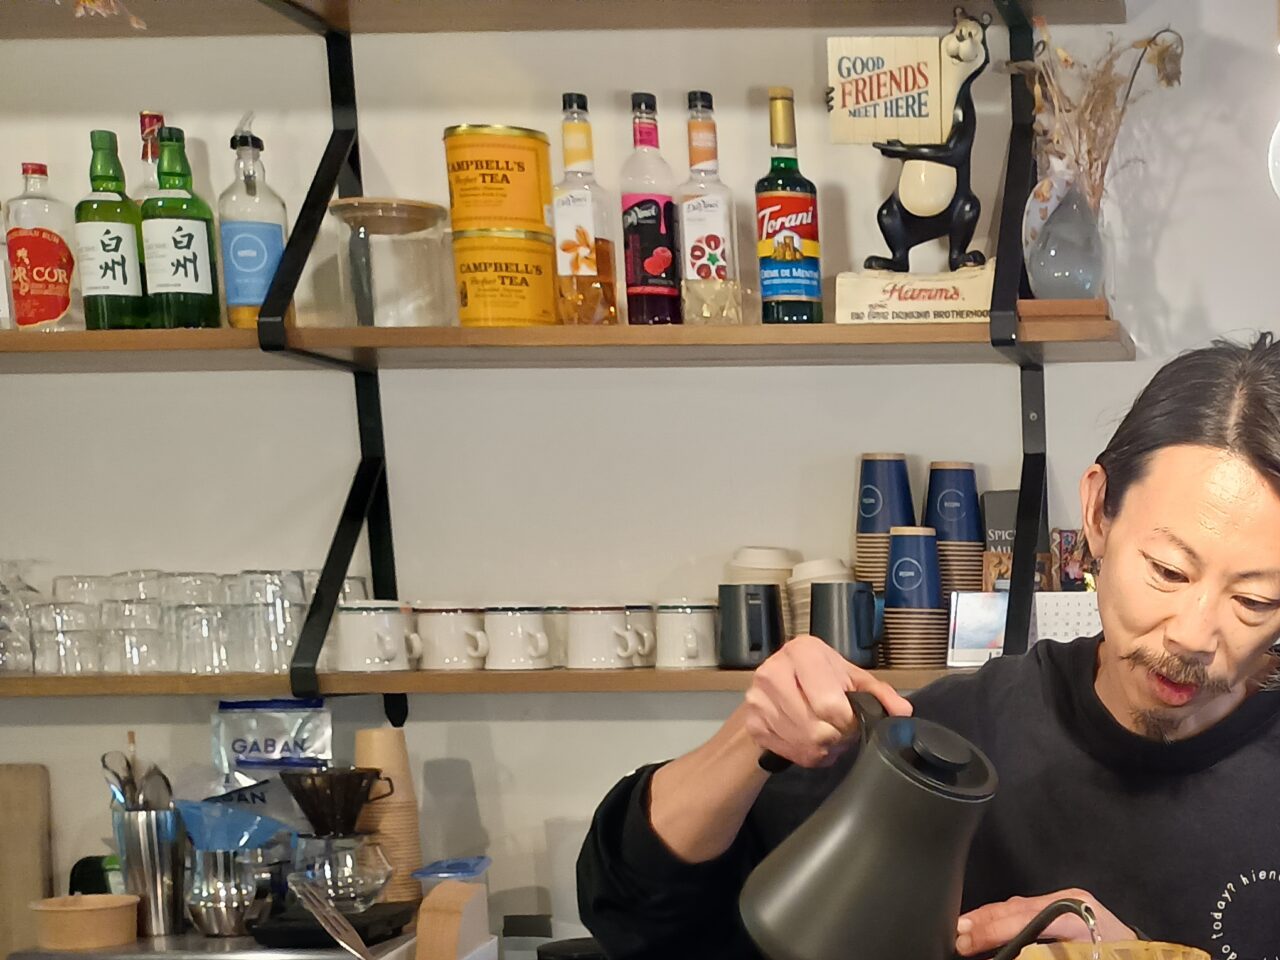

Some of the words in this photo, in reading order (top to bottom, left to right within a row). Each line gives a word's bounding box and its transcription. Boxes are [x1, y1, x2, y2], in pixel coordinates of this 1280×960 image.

[838, 56, 885, 79] GOOD
[841, 62, 929, 109] FRIENDS
[848, 103, 880, 118] MEET
[884, 91, 929, 118] HERE
[479, 173, 511, 184] TEA
[758, 204, 814, 240] Torani
[99, 229, 128, 285] 白州
[171, 226, 199, 282] 白州
[460, 262, 542, 276] CAMPBELL'S
[497, 275, 529, 287] TEA
[933, 309, 990, 319] BROTHERHOO
[988, 528, 1016, 541] SPIC
[232, 739, 307, 754] GABAN
[1210, 882, 1236, 939] today?
